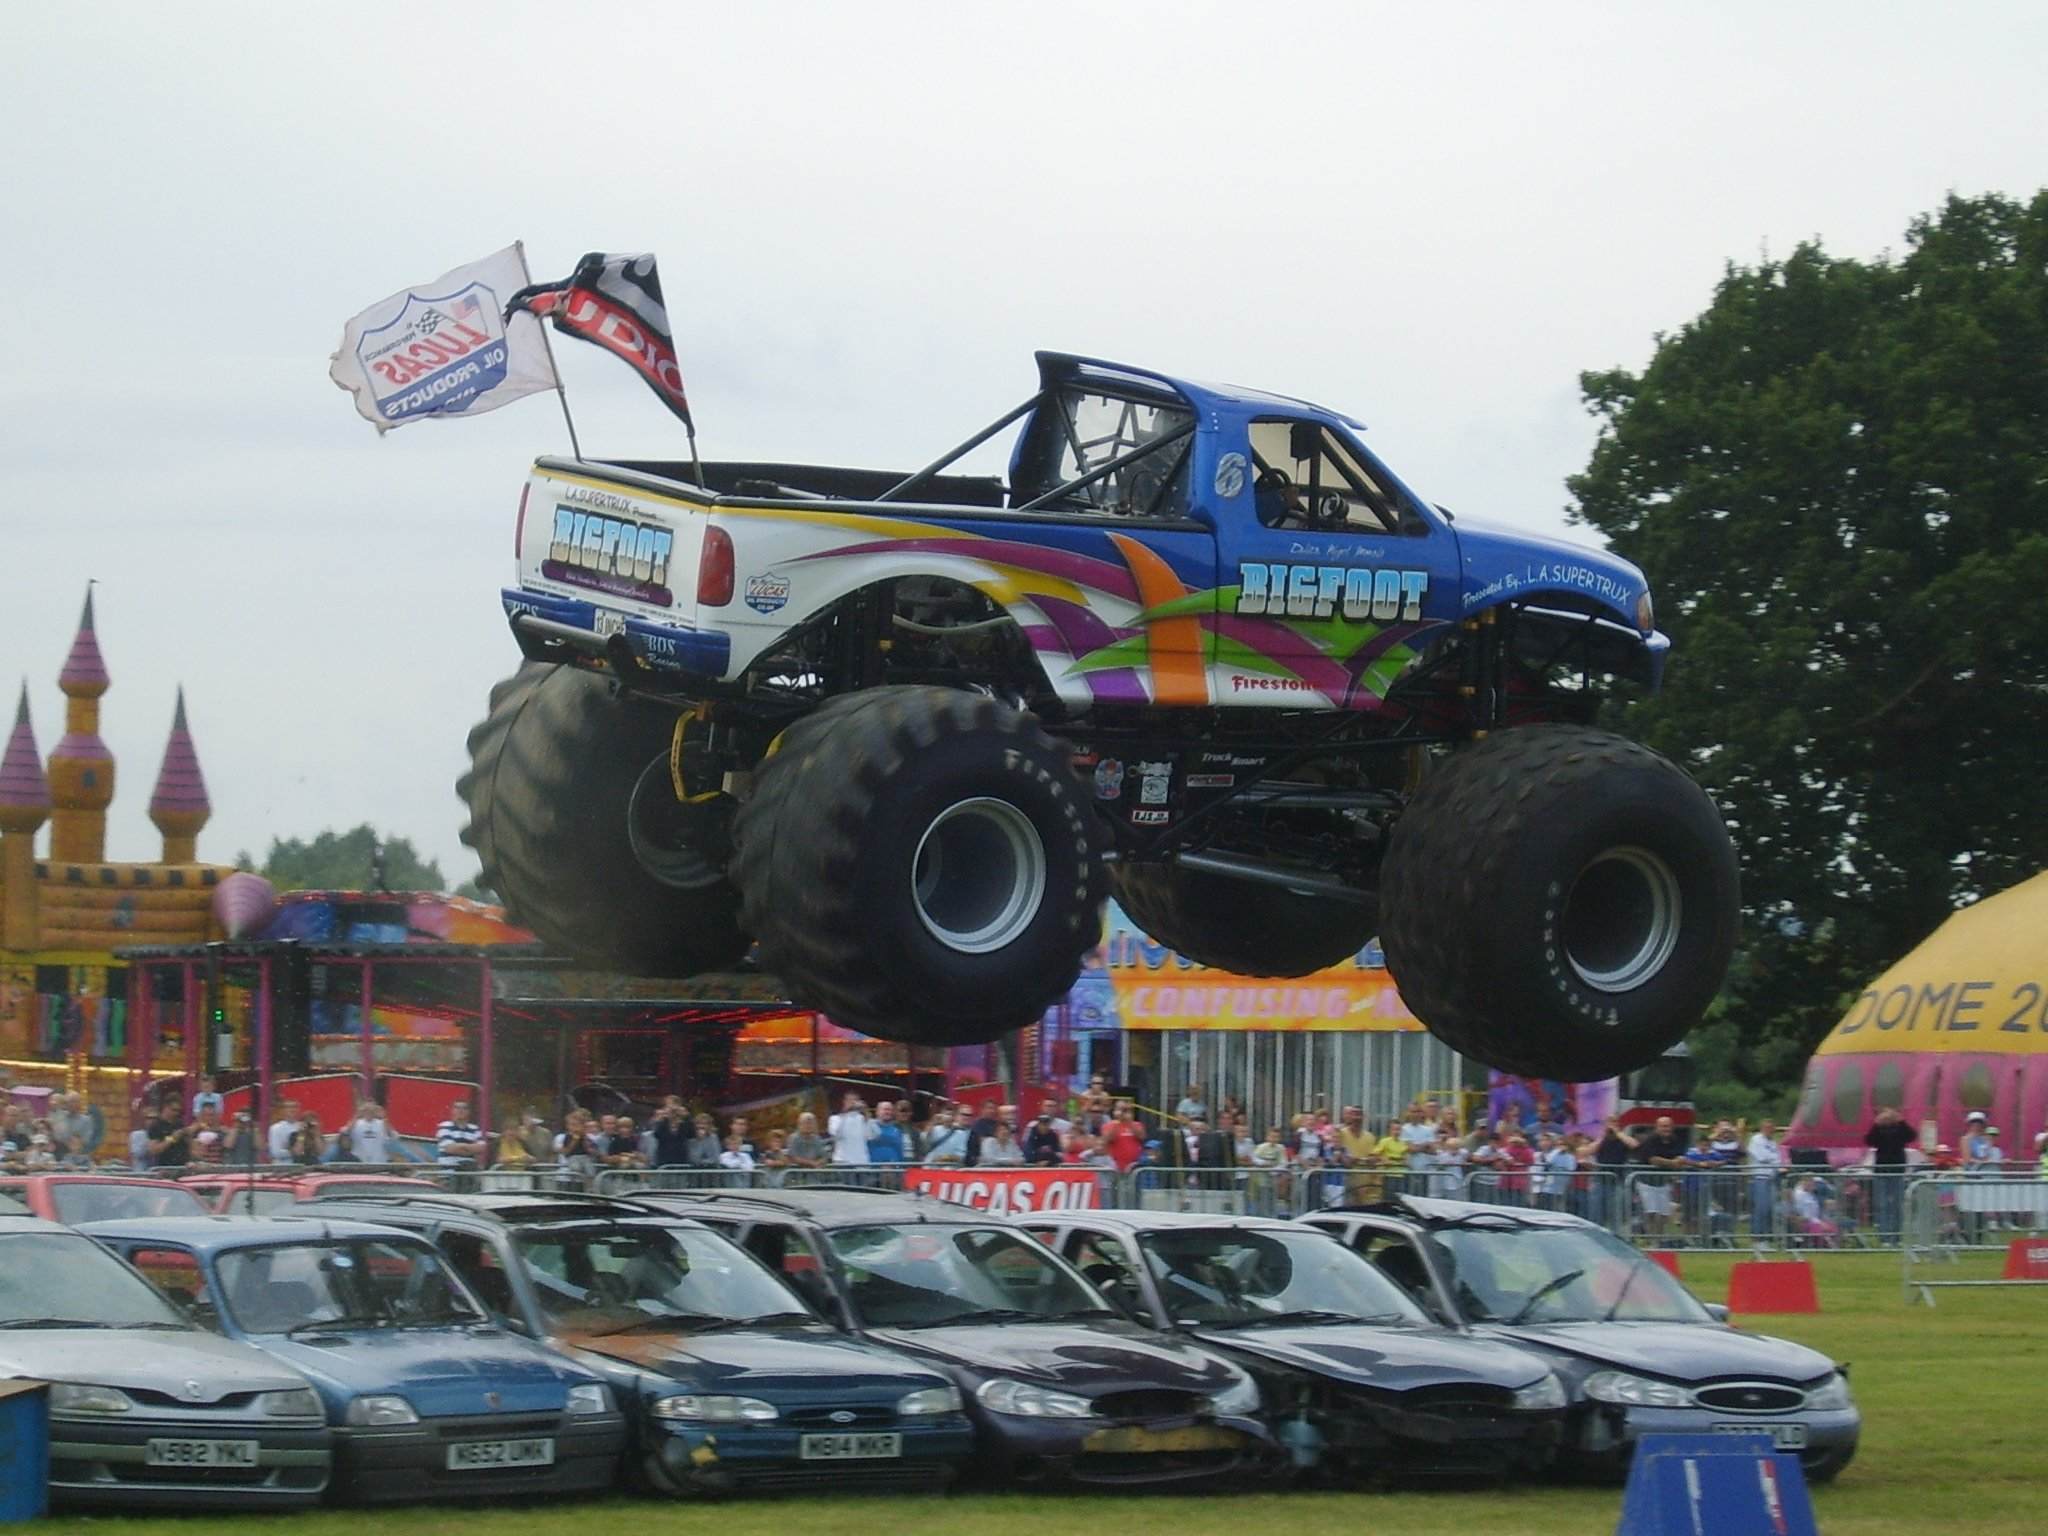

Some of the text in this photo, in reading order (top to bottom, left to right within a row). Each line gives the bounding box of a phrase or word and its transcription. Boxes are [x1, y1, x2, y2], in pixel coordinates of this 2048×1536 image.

[550, 506, 673, 587] BIGFOOT
[1237, 562, 1429, 621] BIGFOOT
[1133, 986, 1350, 1018] CONFUSING
[1839, 982, 1995, 1034] DOME
